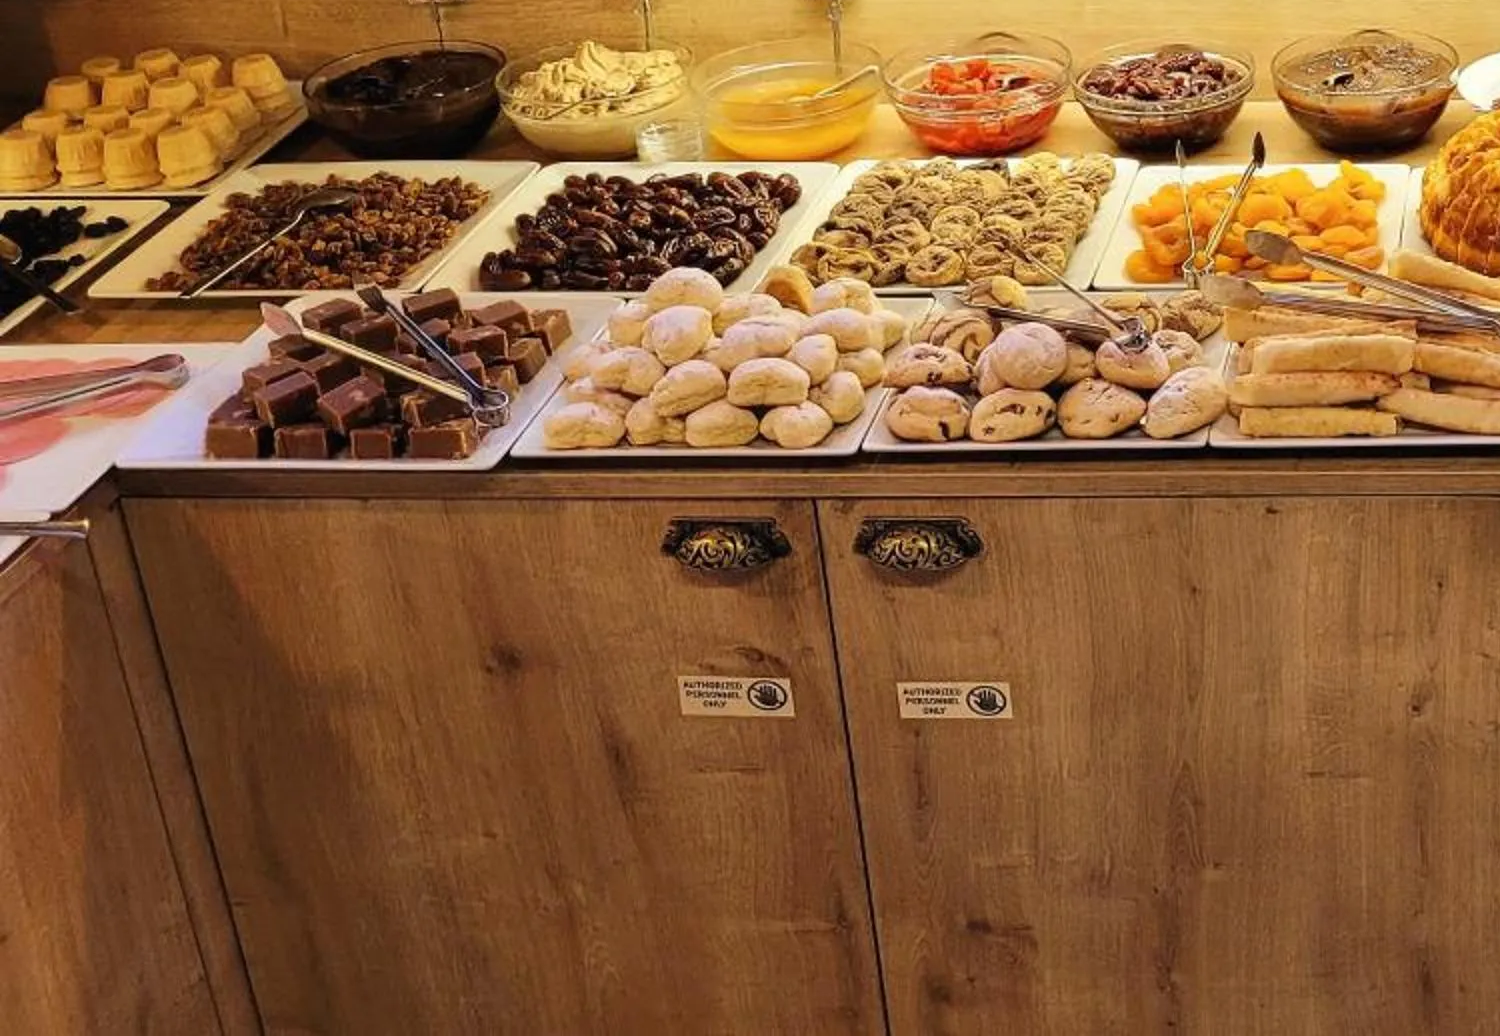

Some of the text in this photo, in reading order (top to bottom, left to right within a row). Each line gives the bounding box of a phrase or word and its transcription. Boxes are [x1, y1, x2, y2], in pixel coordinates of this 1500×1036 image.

[683, 681, 743, 690] AUTHORIZED
[903, 687, 963, 697] AUTHORIZED
[703, 699, 728, 709] ONLY
[922, 706, 946, 715] ONLY
